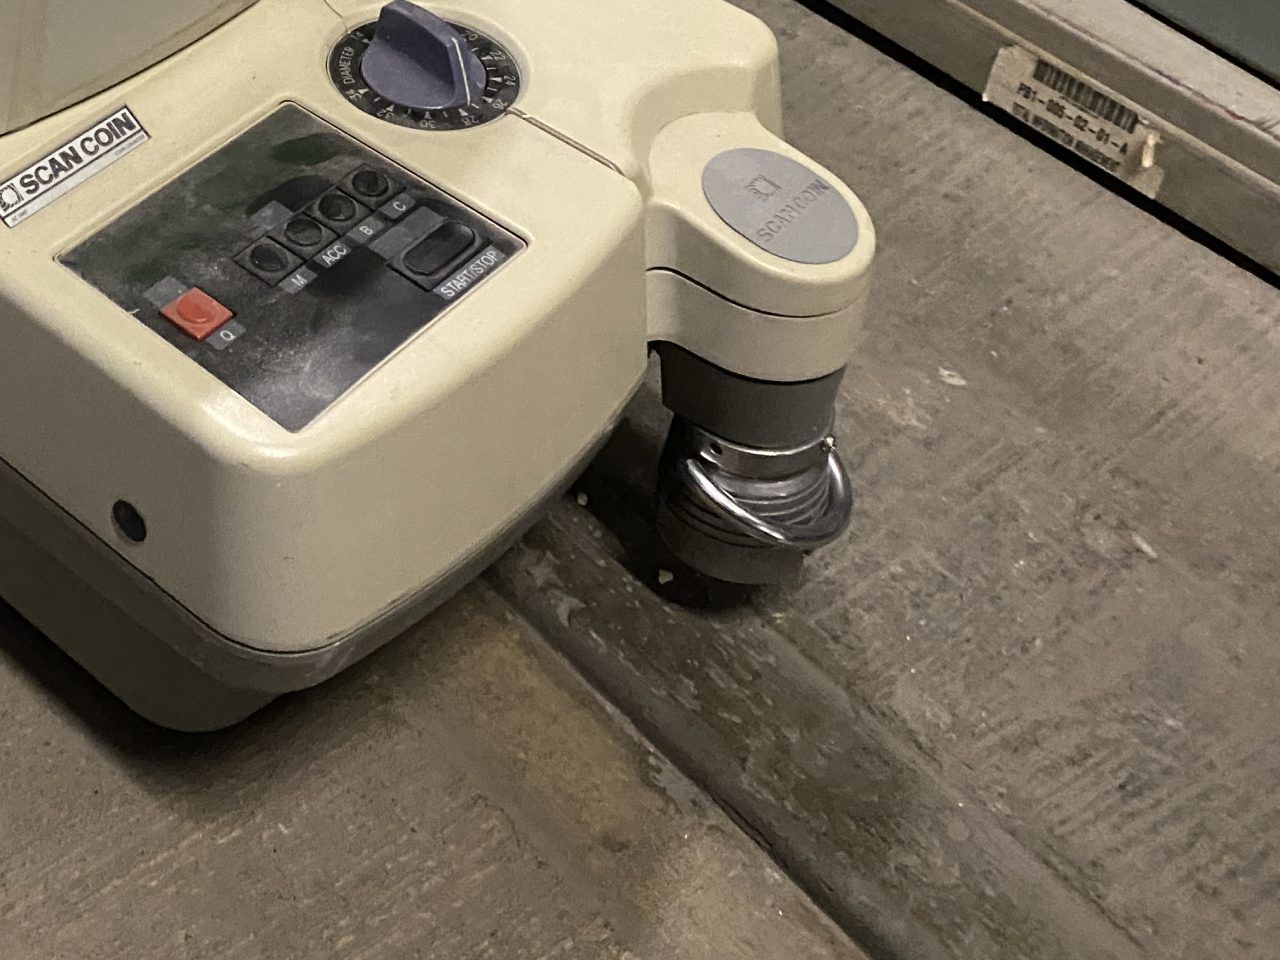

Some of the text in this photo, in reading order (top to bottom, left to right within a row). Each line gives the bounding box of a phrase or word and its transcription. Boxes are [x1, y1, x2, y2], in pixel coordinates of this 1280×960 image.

[19, 146, 83, 195] SCAN
[80, 112, 137, 157] COIN
[392, 201, 406, 211] C
[359, 225, 373, 236] B
[756, 203, 797, 242] SCAN
[321, 245, 347, 267] ACC
[290, 274, 308, 287] M
[440, 250, 498, 297] START/STOP
